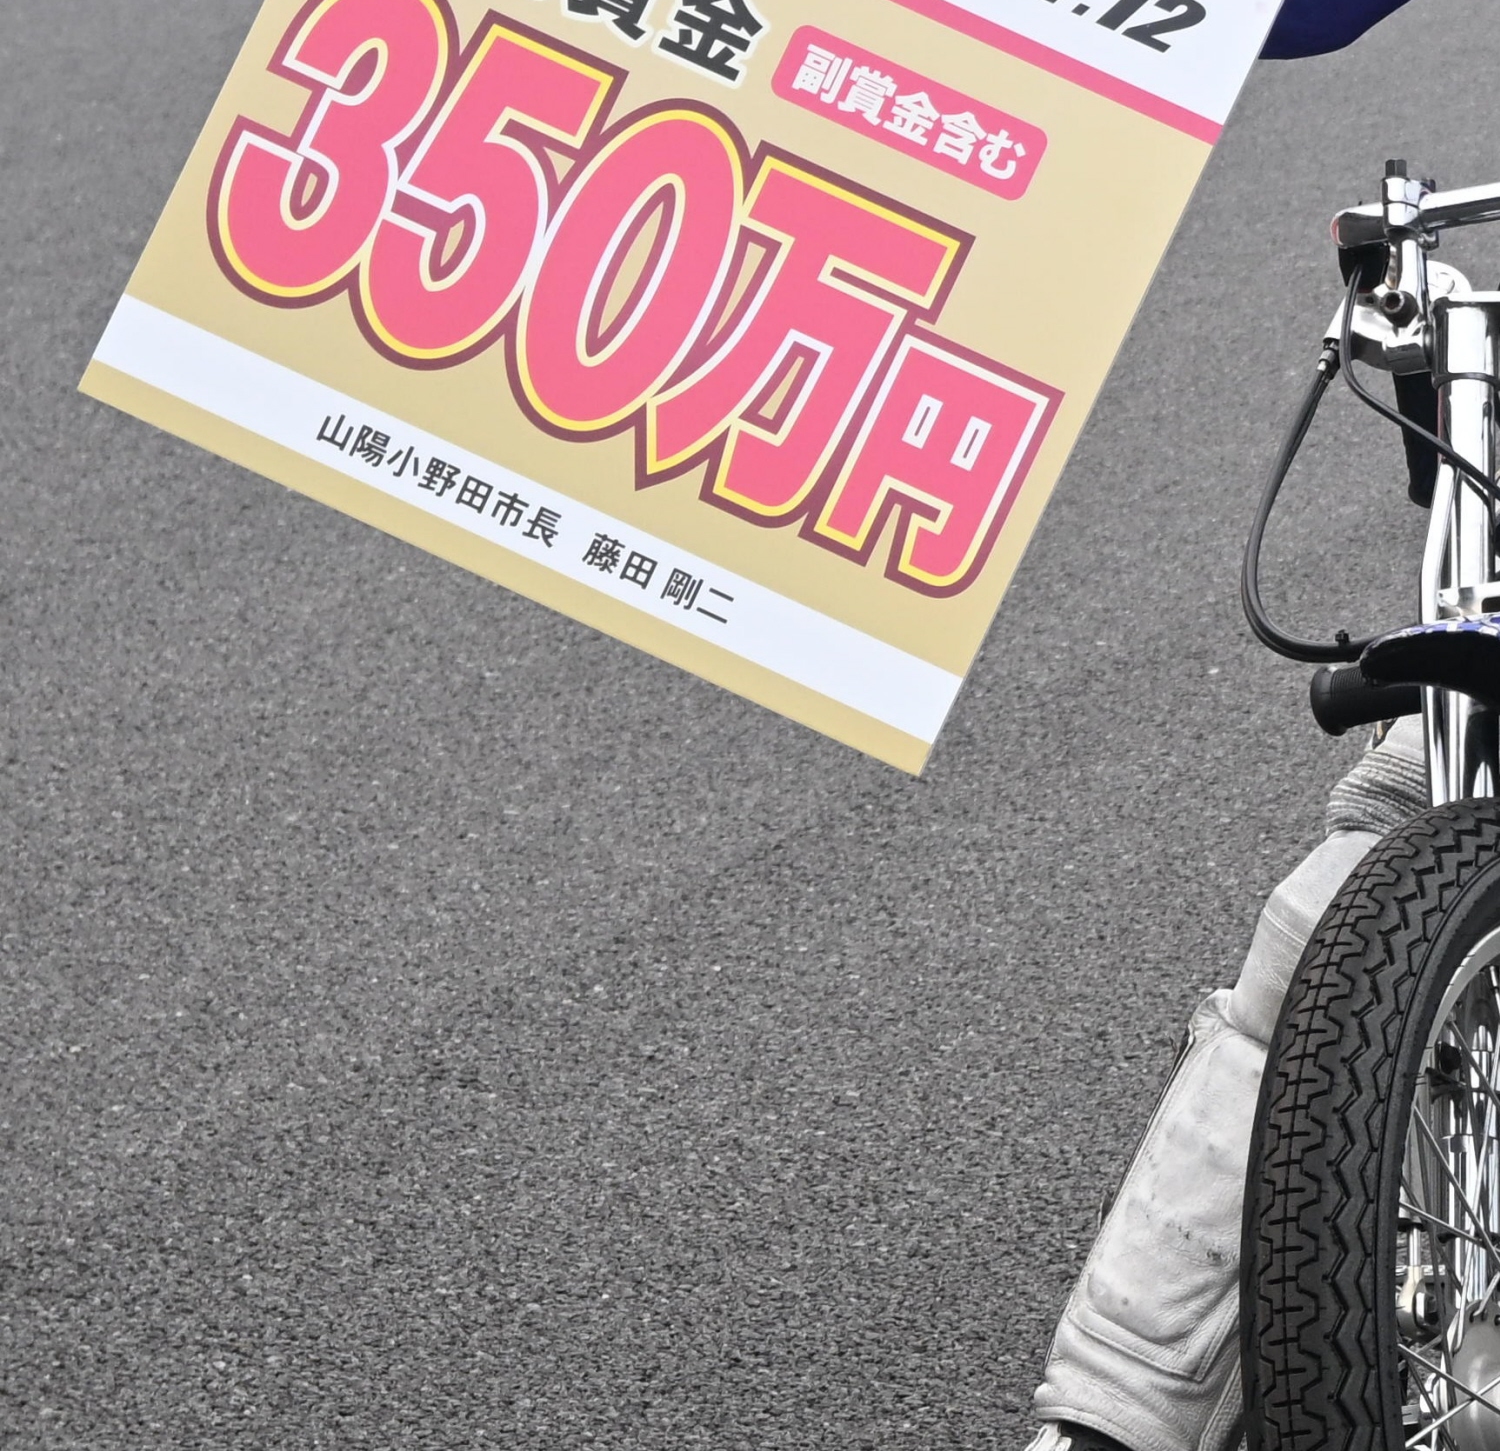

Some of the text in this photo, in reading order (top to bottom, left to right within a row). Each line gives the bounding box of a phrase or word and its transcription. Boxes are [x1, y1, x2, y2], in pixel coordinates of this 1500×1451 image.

[790, 43, 1028, 182] 副賞金含む
[316, 414, 735, 624] 山陽小野田市長 藤田 剛二
